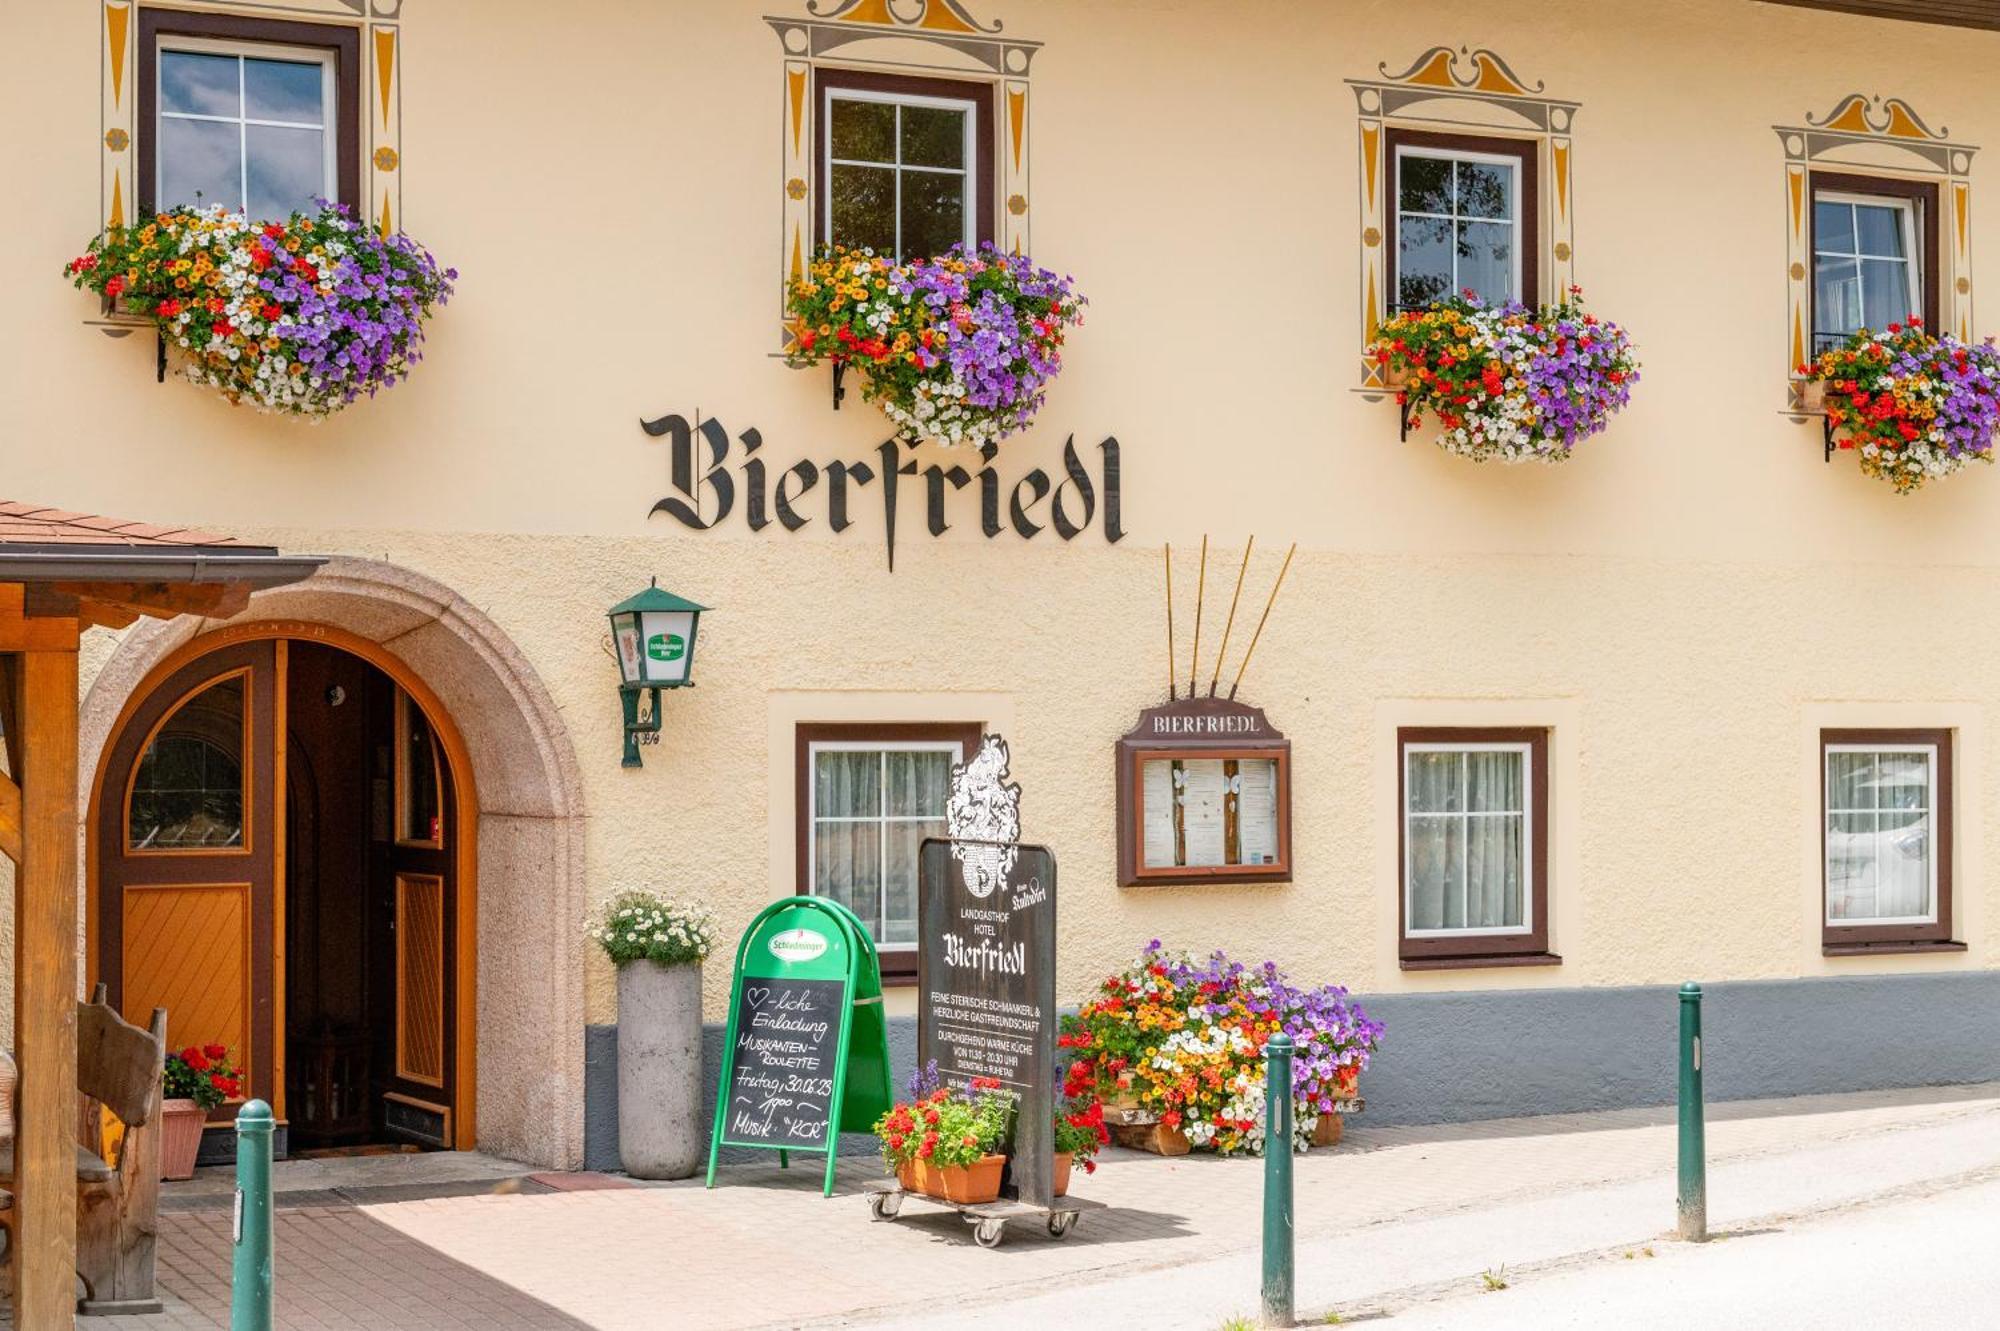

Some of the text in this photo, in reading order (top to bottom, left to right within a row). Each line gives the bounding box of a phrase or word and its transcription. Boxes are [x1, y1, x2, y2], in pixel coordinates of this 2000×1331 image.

[639, 407, 1128, 573] Bierfriedl
[1153, 715, 1261, 733] BIERFRIEDL
[960, 907, 1011, 923] LANDGASTHOF
[974, 923, 998, 937] HOTEL
[941, 931, 1026, 982] Bierfriedl
[931, 991, 1041, 1018] FEINE STEIRISCHE SCHMANKERL &
[751, 1011, 828, 1043] Einladung
[932, 1006, 1040, 1033] HERZLICHE GASTFREUNDSCHAFT
[938, 1030, 1033, 1056] DURCHGEHEND WARME KÜCHE
[759, 1050, 820, 1070] ROULETTE
[953, 1045, 968, 1057] VON
[1003, 1054, 1019, 1067] UHR
[988, 1064, 1014, 1078] RUHETAG
